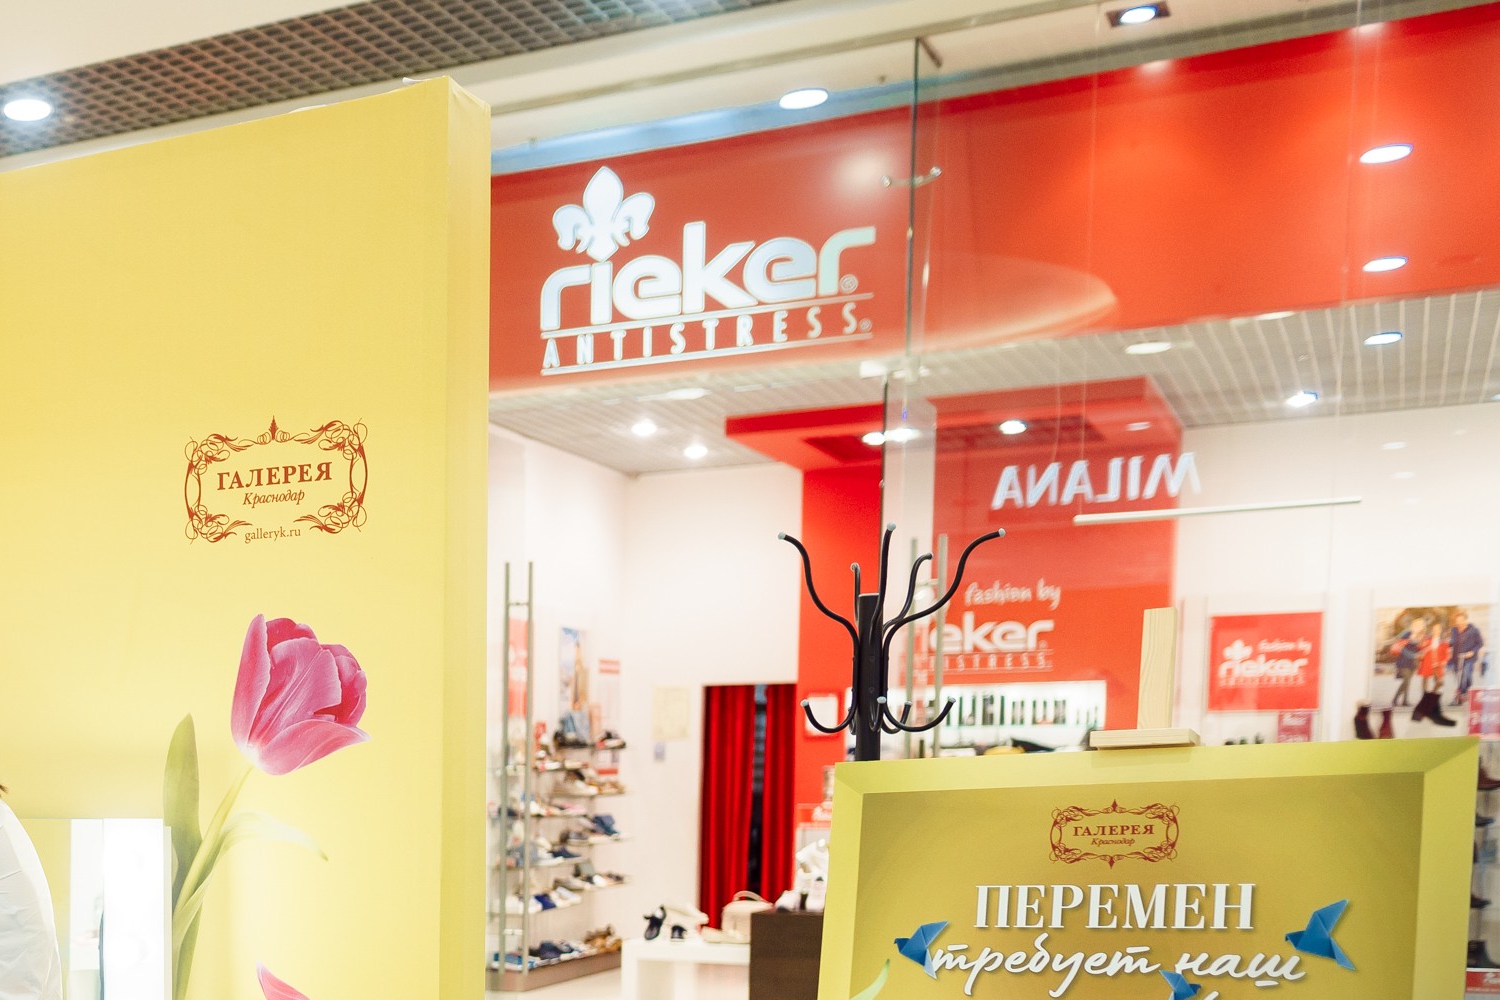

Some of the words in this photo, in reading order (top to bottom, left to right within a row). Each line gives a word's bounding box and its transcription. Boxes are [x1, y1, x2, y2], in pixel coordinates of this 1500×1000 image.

[540, 221, 877, 332] rieker
[542, 302, 858, 368] ANTISTRESS
[217, 462, 333, 491] ГАЛЕРЕЯ
[243, 489, 305, 508] Краснодар
[244, 526, 301, 543] galleryk.ru
[964, 580, 1032, 606] fashion
[1036, 578, 1061, 610] by
[1073, 825, 1155, 837] ГАЛЕРЕЯ
[1091, 838, 1135, 847] Краснодар
[973, 883, 1256, 929] ПЕРЕМЕН
[932, 932, 1162, 998] требует
[1175, 950, 1306, 987] наш
